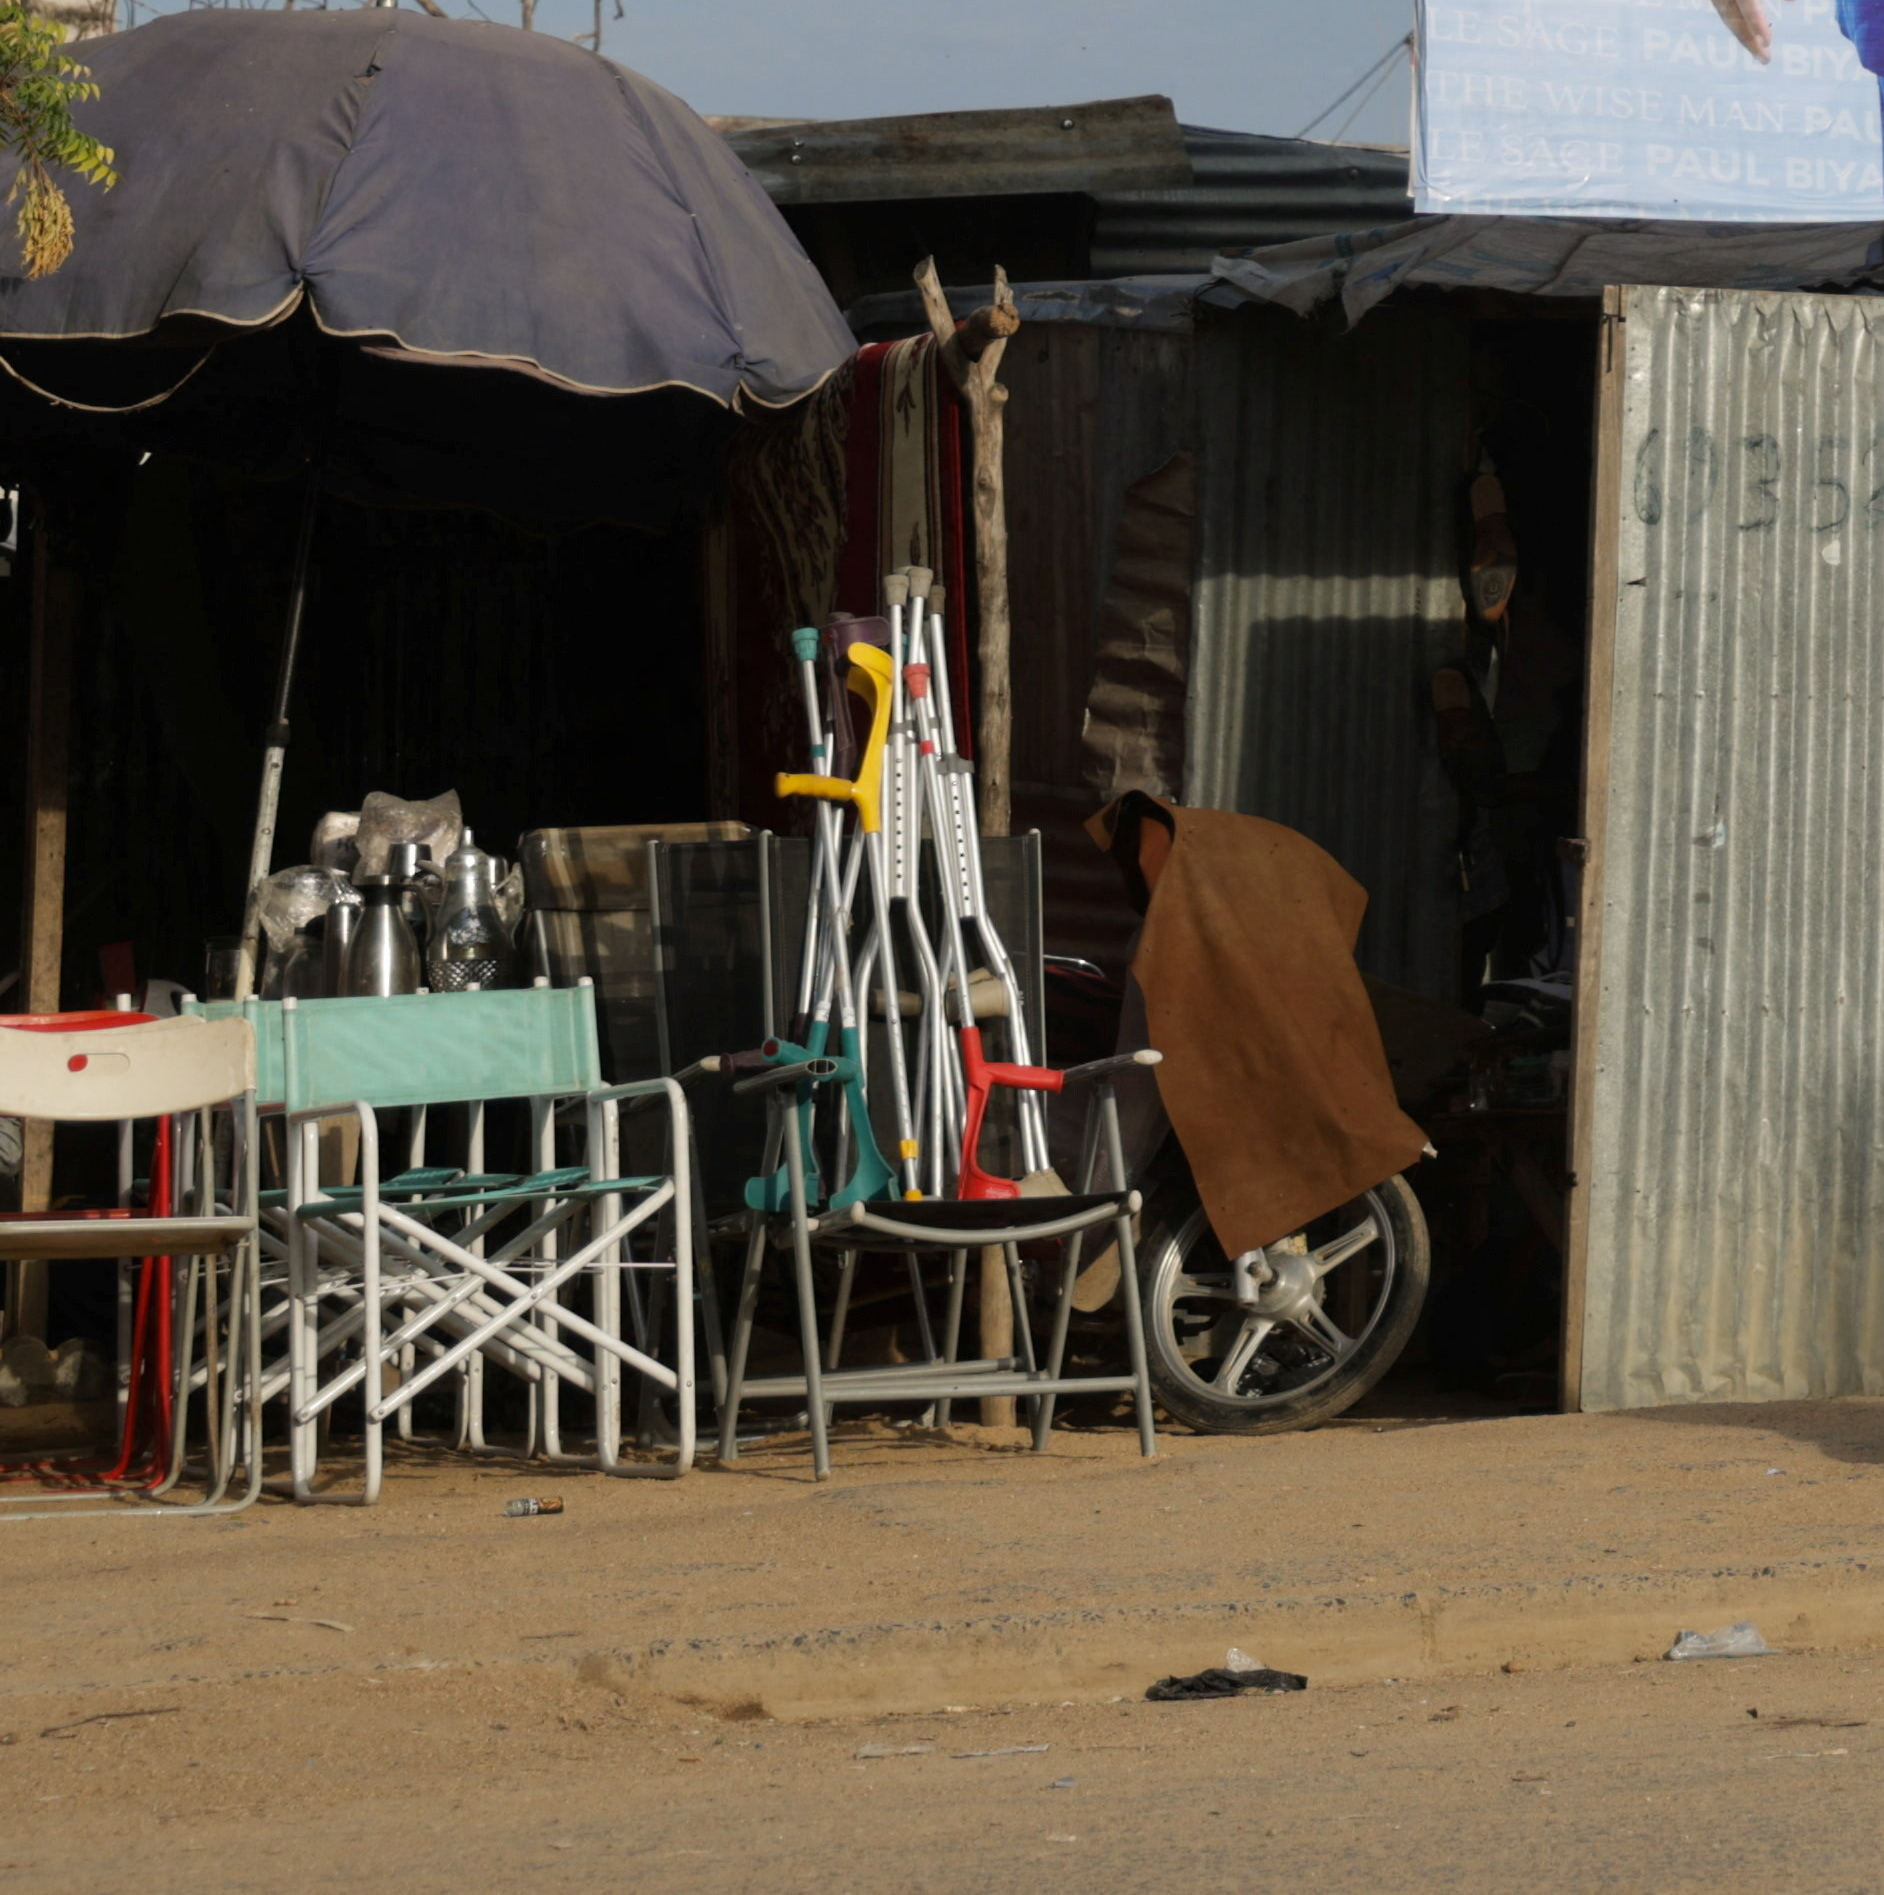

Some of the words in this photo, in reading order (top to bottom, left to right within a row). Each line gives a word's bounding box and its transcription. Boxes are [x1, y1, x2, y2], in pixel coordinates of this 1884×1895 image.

[1497, 15, 1620, 58] SAGE
[1428, 68, 1528, 109] THE
[1542, 81, 1664, 122] WISE
[1679, 94, 1784, 131] MAN
[1428, 128, 1484, 162] LE
[1501, 134, 1622, 173] SAGE
[1648, 144, 1771, 186] PAUL
